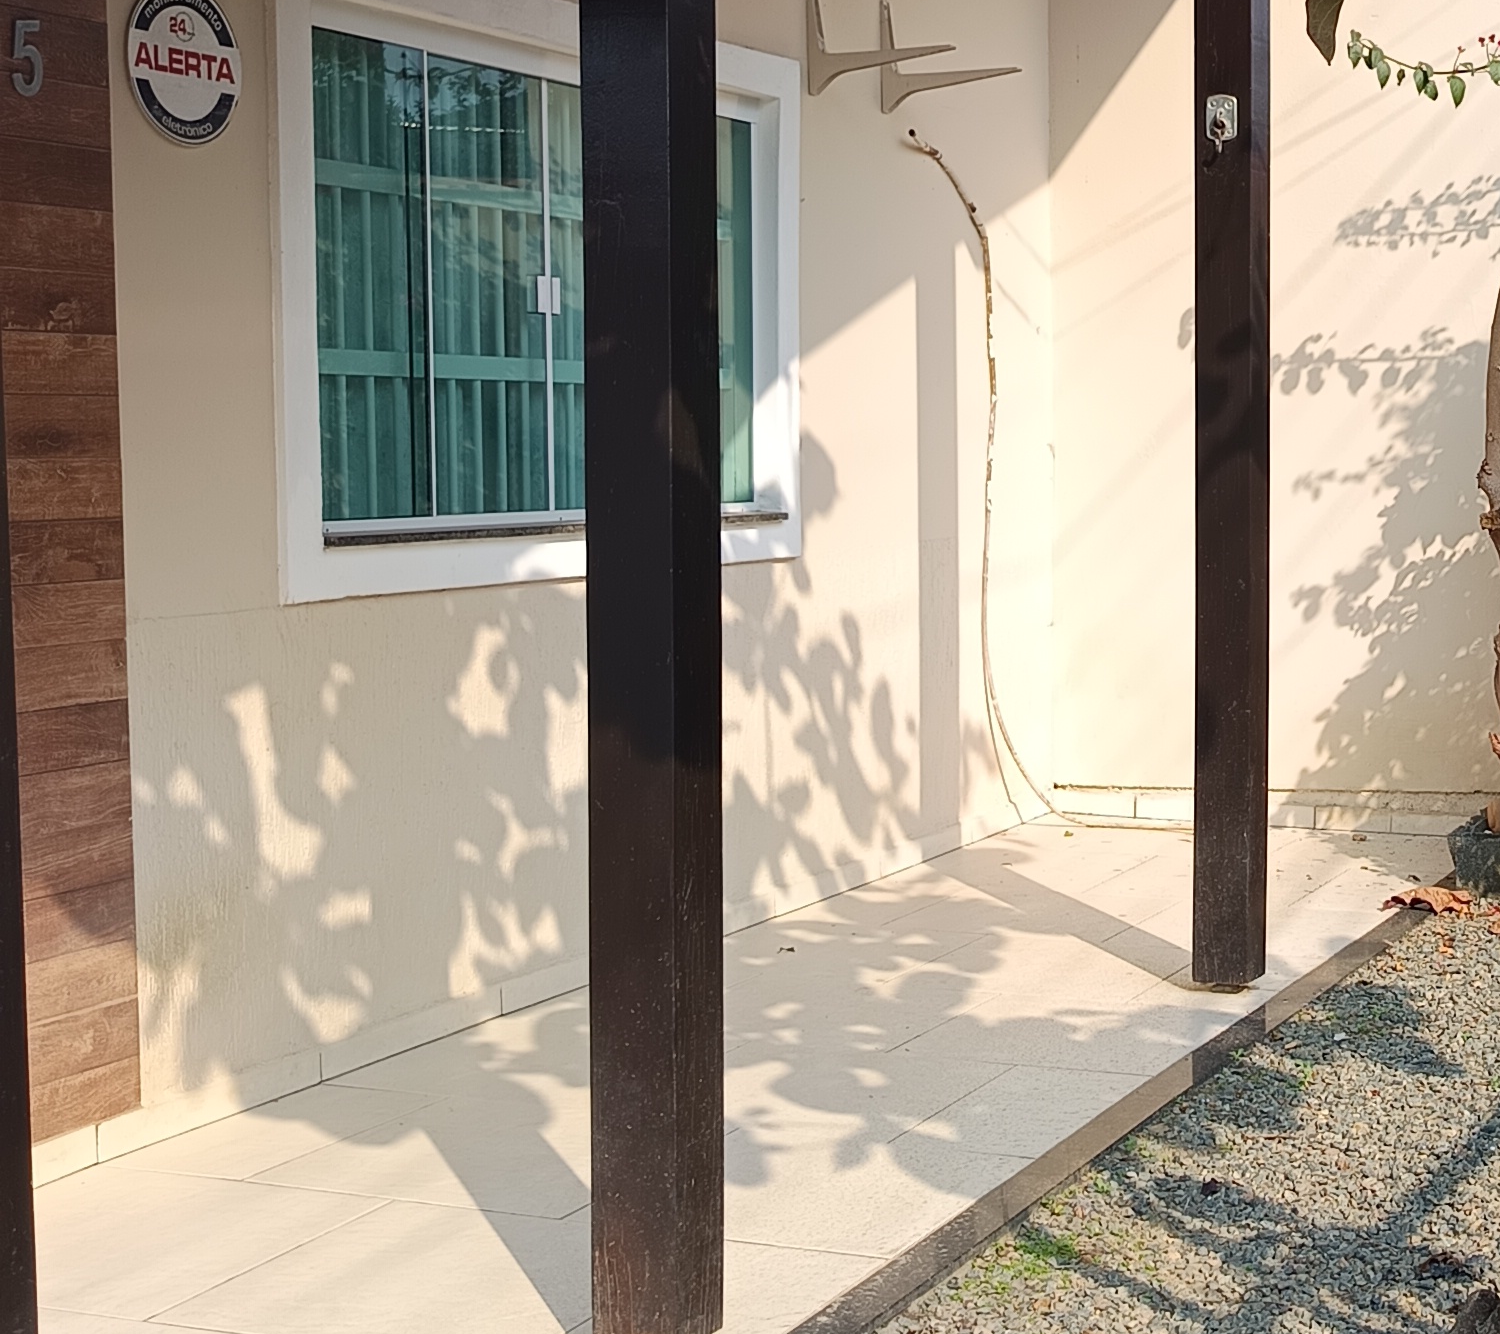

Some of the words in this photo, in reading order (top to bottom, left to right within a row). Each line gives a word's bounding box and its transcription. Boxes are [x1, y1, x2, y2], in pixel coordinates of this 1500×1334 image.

[169, 17, 187, 35] 24
[12, 20, 43, 97] 5
[134, 41, 235, 84] ALERTA
